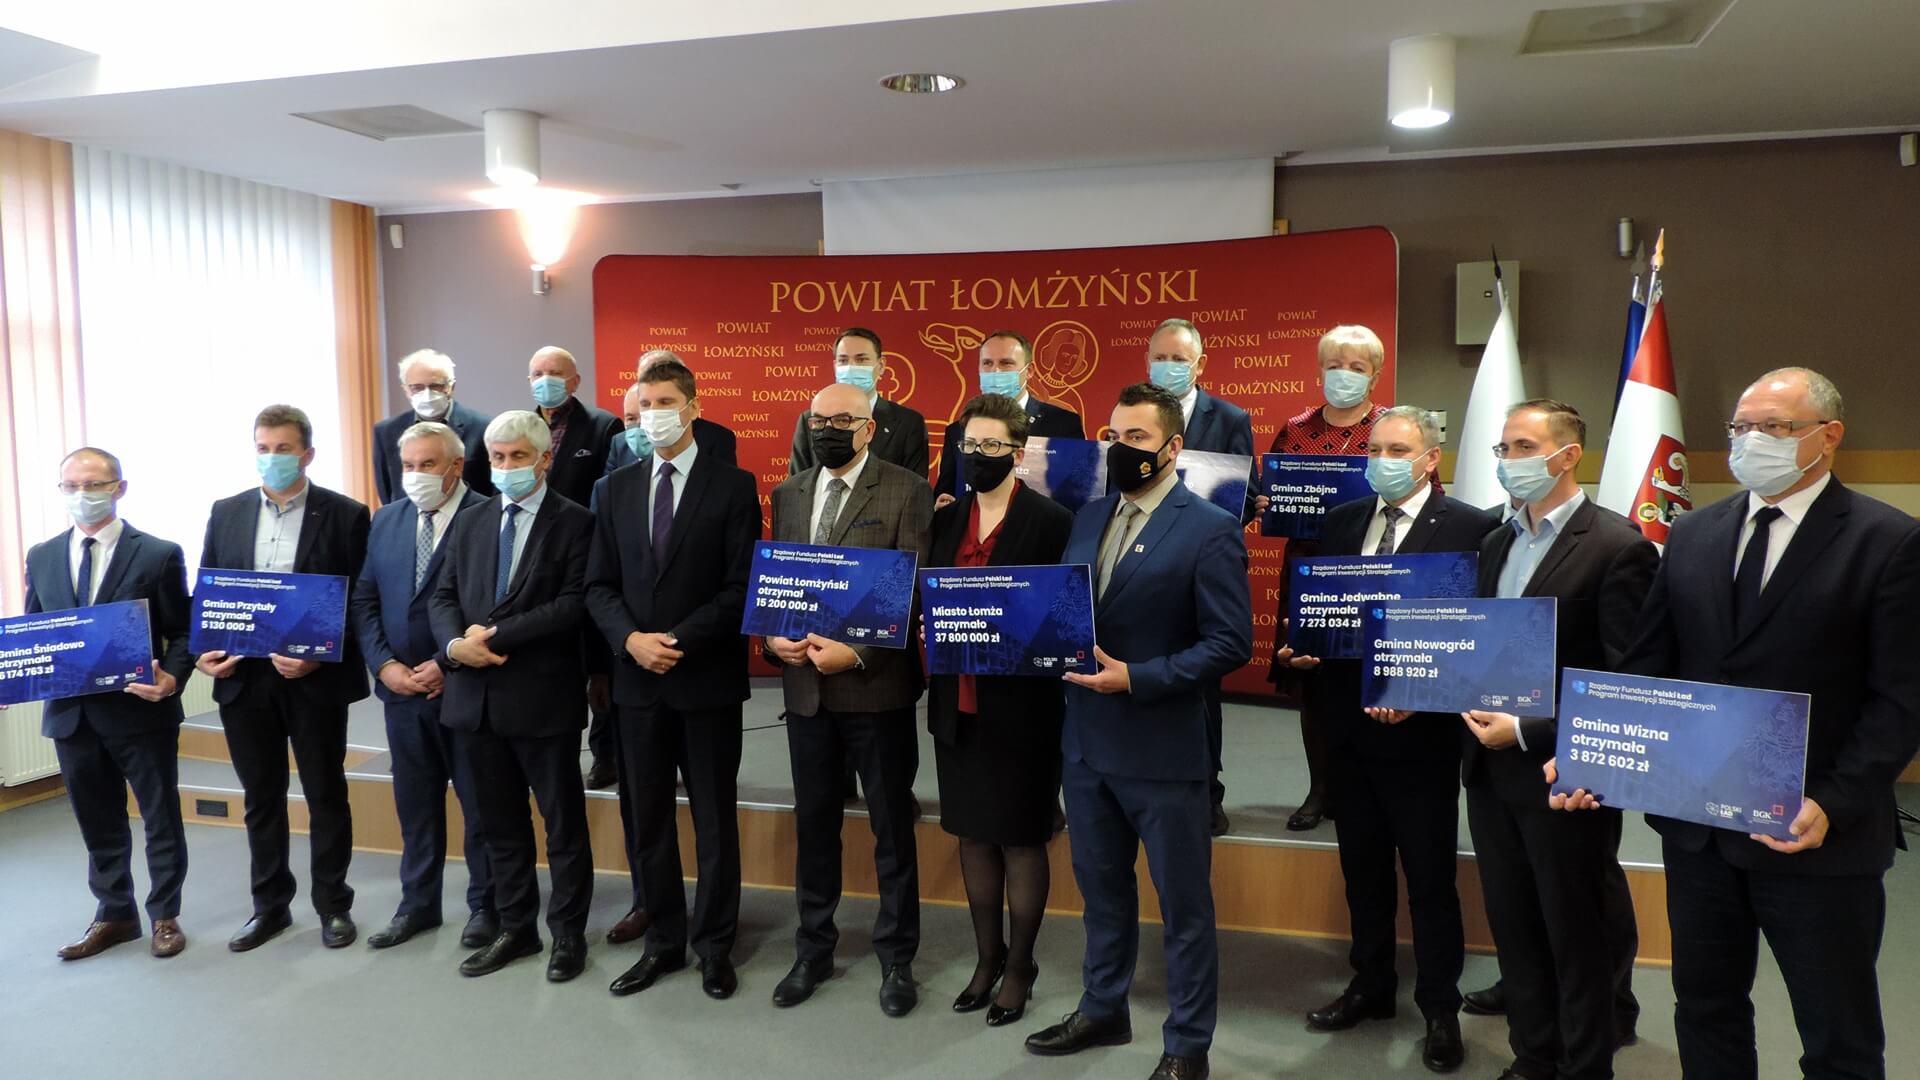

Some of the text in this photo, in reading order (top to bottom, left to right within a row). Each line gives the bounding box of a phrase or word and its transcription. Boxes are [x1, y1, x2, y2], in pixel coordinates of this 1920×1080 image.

[770, 268, 1198, 312] POWIAT ŁOMŻYŃSKI
[1191, 309, 1247, 323] POWIAT
[1277, 310, 1318, 321] POWIAT
[717, 322, 771, 334] POWIAT
[1120, 319, 1158, 329] POWIAT
[649, 327, 688, 336] POWIAT
[804, 327, 840, 336] POWIAT
[1268, 328, 1327, 340] ŁOMŻYŃSKI
[640, 342, 697, 352] ŁOMŻYŃSKI
[704, 344, 784, 358] ŁOMŻYŃSKI
[1234, 355, 1291, 369] POWIAT
[695, 372, 732, 380] POWIAT
[765, 366, 819, 378] POWIAT
[1219, 379, 1304, 396] ŁOMŻYŃSKI
[733, 413, 770, 422] POWIAT
[1271, 484, 1337, 496] Gmina Zbójna
[1271, 494, 1319, 505] otrzymała
[1279, 505, 1297, 513] 548
[1298, 505, 1315, 514] 768
[1316, 506, 1325, 514] zł
[1247, 549, 1280, 559] OWIAT
[759, 574, 849, 591] Powiat Łomżyński
[758, 586, 804, 599] otrzymał
[1300, 592, 1401, 603] Gmina Jedwabne
[203, 599, 277, 613] Gmina Przytuły
[756, 598, 818, 612] 15 200 000 zł
[932, 605, 1003, 617] Miasto Łomża
[1300, 605, 1358, 617] otrzymała
[202, 610, 252, 621] otrzymała
[201, 620, 255, 632] 5 130 000 zł
[933, 619, 987, 632] otrzymało
[1299, 618, 1361, 628] 7 273 034 zł
[935, 633, 1000, 643] 37 800 000 zł
[33, 641, 85, 654] Śniadowo
[1374, 638, 1475, 653] Gmina Nowogród
[1374, 652, 1432, 665] otrzymała
[6, 669, 24, 679] 174
[24, 666, 43, 677] 763
[44, 665, 55, 674] zł
[1374, 666, 1438, 678] 8 988 920 zł
[1653, 689, 1676, 699] Polski
[1677, 691, 1692, 700] Ład
[1572, 717, 1669, 741] Gmina Wizna
[1571, 733, 1645, 754] otrzymała
[1570, 748, 1649, 772] 3 872 602 zł
[1753, 809, 1772, 819] BGK
